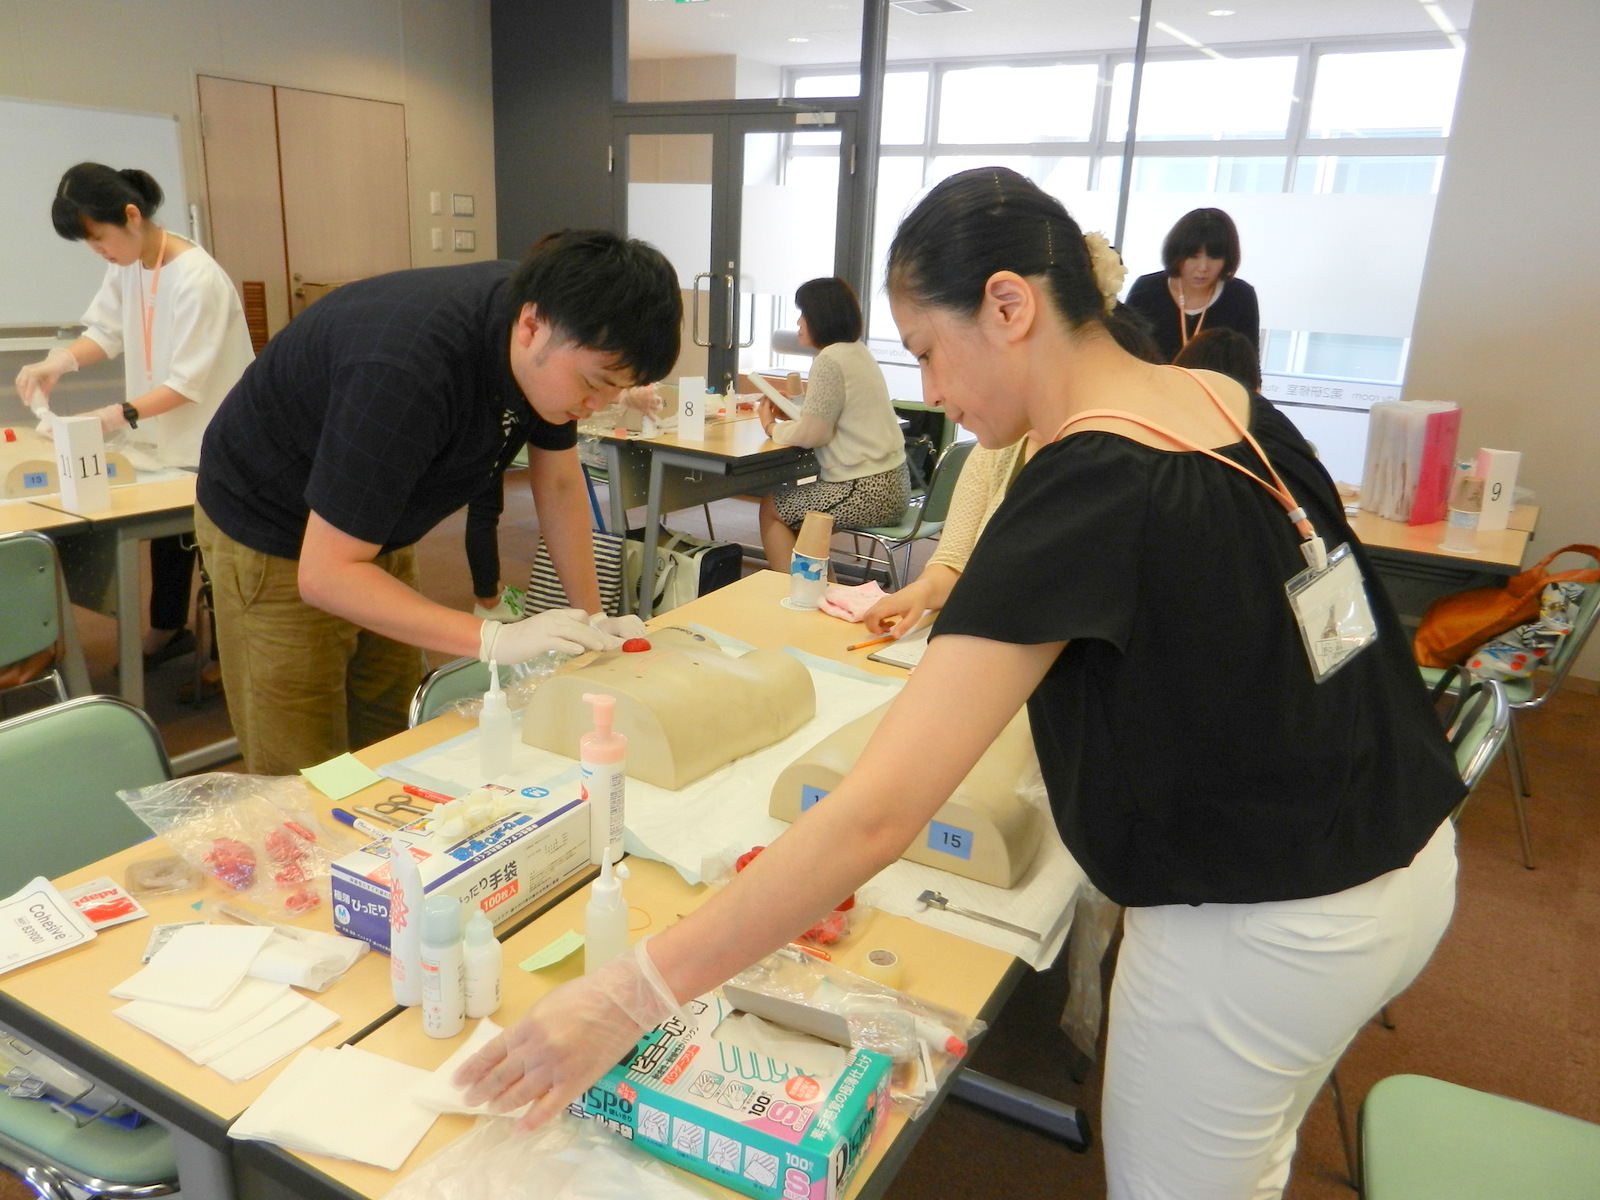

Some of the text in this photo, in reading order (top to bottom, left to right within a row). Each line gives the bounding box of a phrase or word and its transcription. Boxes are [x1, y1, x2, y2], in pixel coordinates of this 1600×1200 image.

[684, 401, 694, 417] 8
[80, 453, 101, 478] 11
[1491, 482, 1502, 501] 9
[943, 832, 962, 849] 15
[29, 903, 66, 940] Cohesive
[767, 1101, 802, 1126] S
[785, 1168, 811, 1196] S
